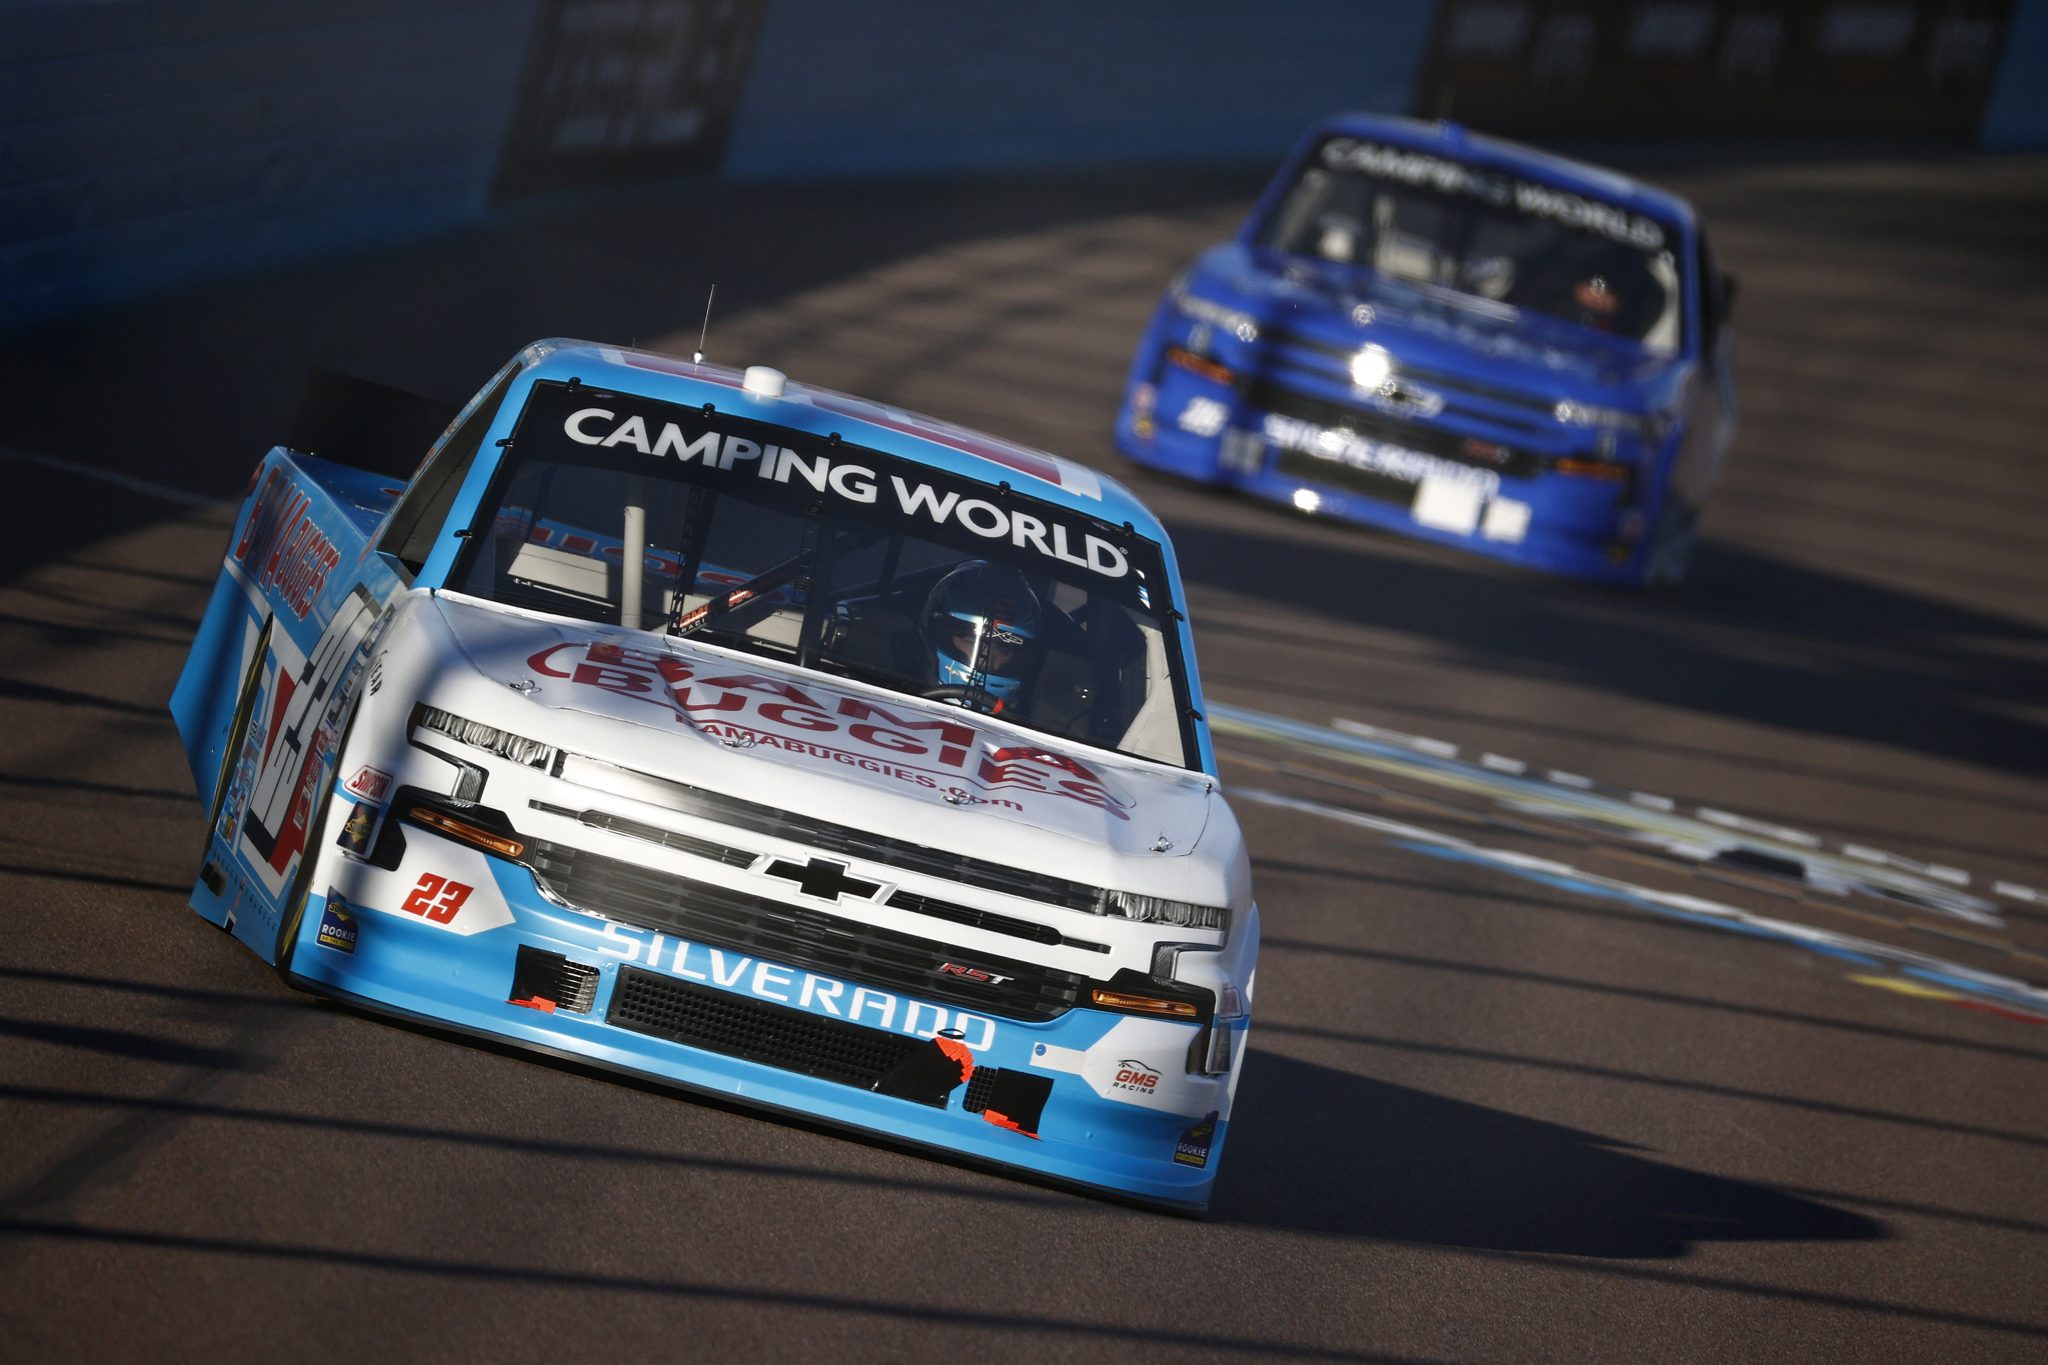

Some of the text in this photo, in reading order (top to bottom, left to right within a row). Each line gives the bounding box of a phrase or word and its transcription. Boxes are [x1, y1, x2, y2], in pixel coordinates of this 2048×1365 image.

[1514, 181, 1666, 250] WORLD
[564, 407, 877, 503] CAMPING
[571, 663, 1131, 821] BUGGIES
[400, 871, 475, 925] 23
[321, 923, 357, 942] ROOKIE
[597, 922, 997, 1052] SILVERADO
[937, 962, 1015, 984] RST
[1112, 1081, 1155, 1095] RACING
[1115, 1069, 1159, 1089] GMS
[1177, 1142, 1207, 1157] ROOKIE
